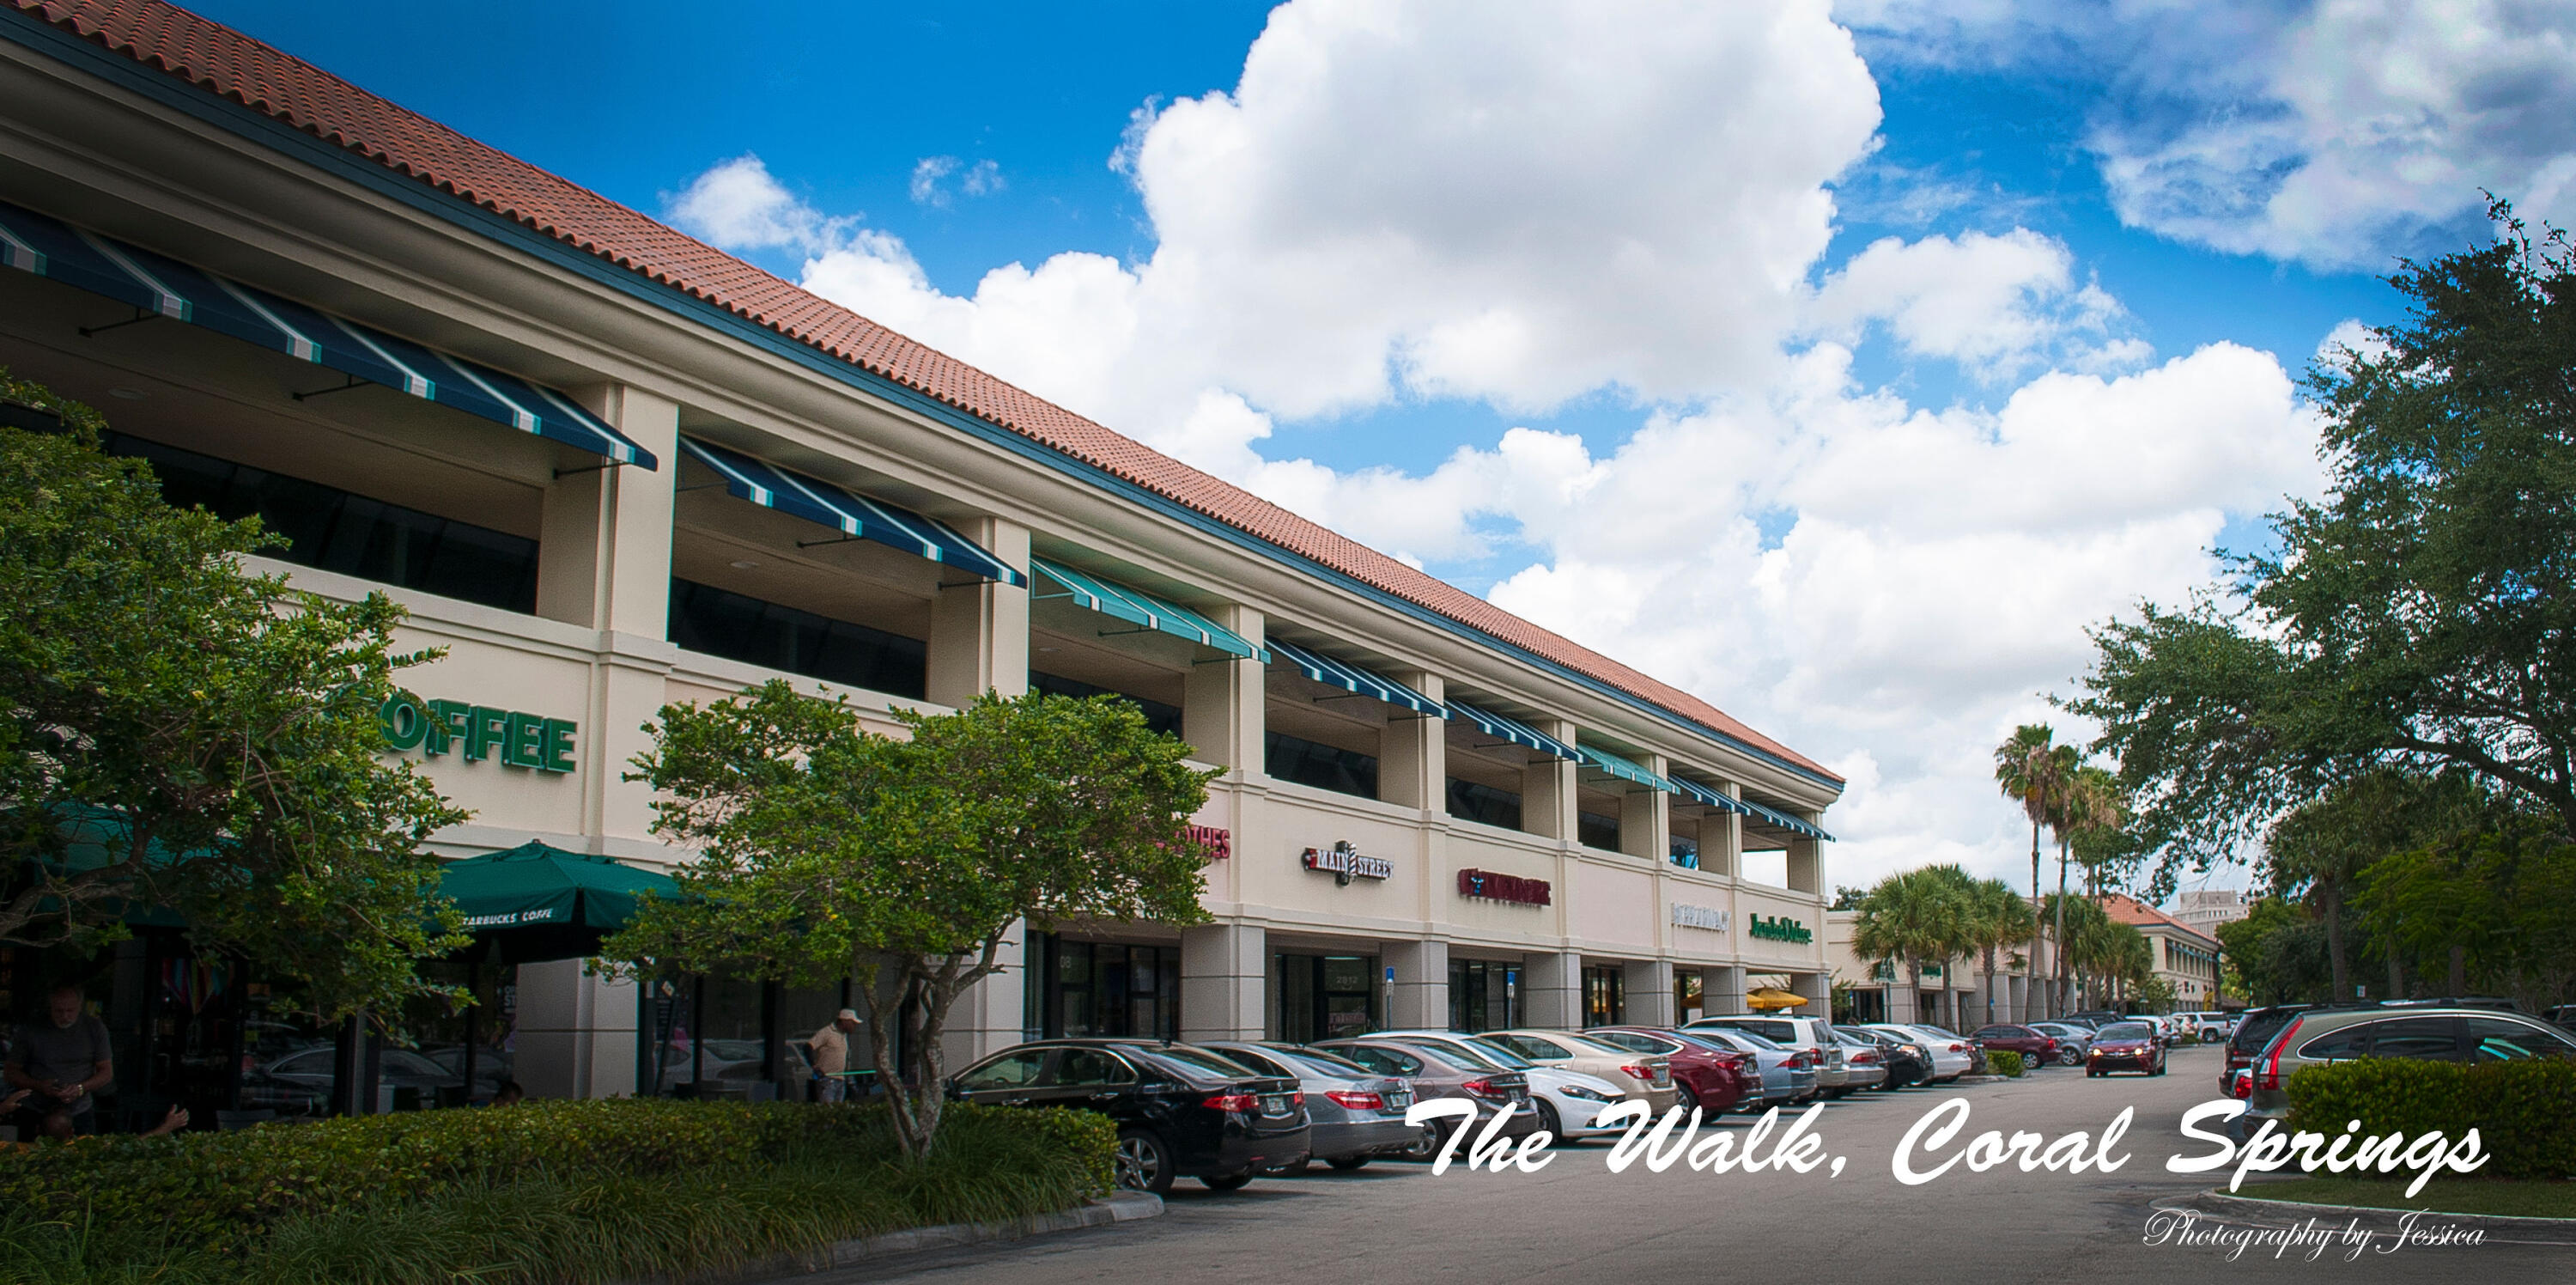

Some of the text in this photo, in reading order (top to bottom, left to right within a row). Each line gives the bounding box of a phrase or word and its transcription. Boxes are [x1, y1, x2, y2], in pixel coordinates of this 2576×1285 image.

[376, 690, 578, 774] OFFEE
[1316, 848, 1394, 878] MAIN STREET
[461, 907, 554, 926] TARBUCKS COFFE
